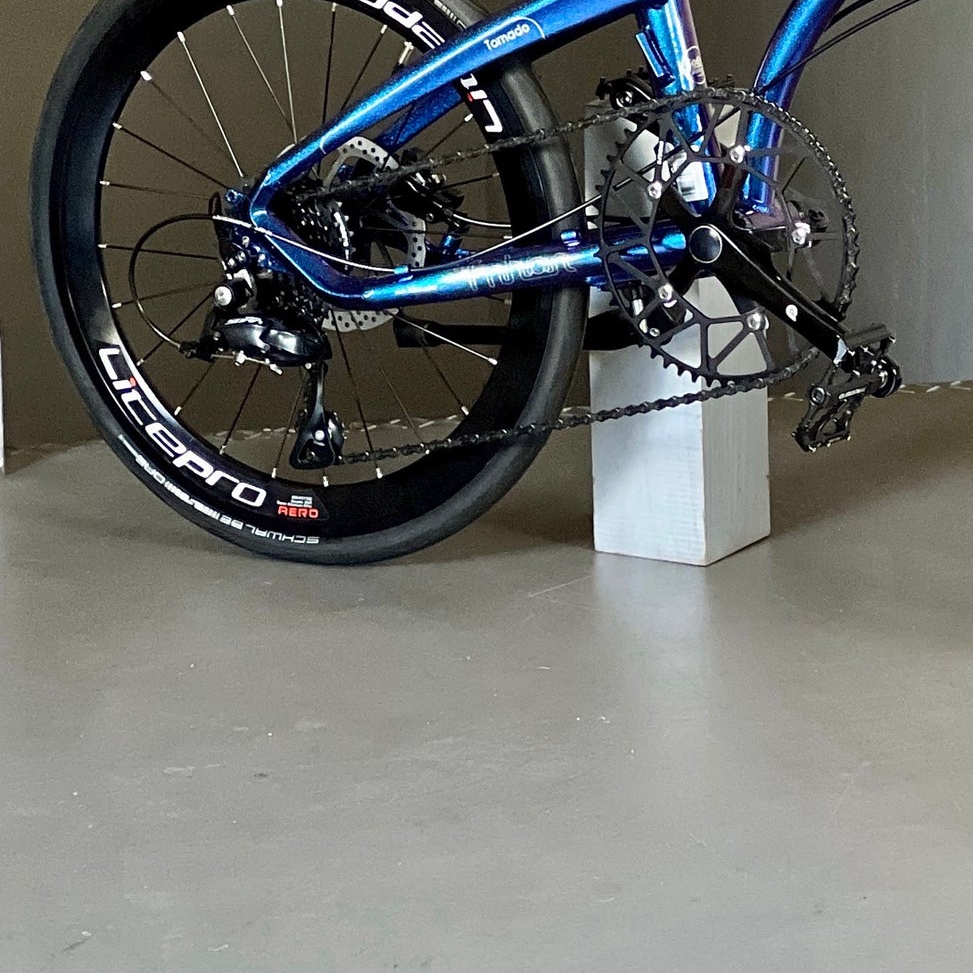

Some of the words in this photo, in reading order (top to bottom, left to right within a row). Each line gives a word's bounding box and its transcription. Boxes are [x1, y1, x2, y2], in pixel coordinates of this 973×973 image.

[483, 23, 531, 51] Tornado
[277, 505, 319, 518] AERO
[220, 515, 320, 545] SCHWALBE
